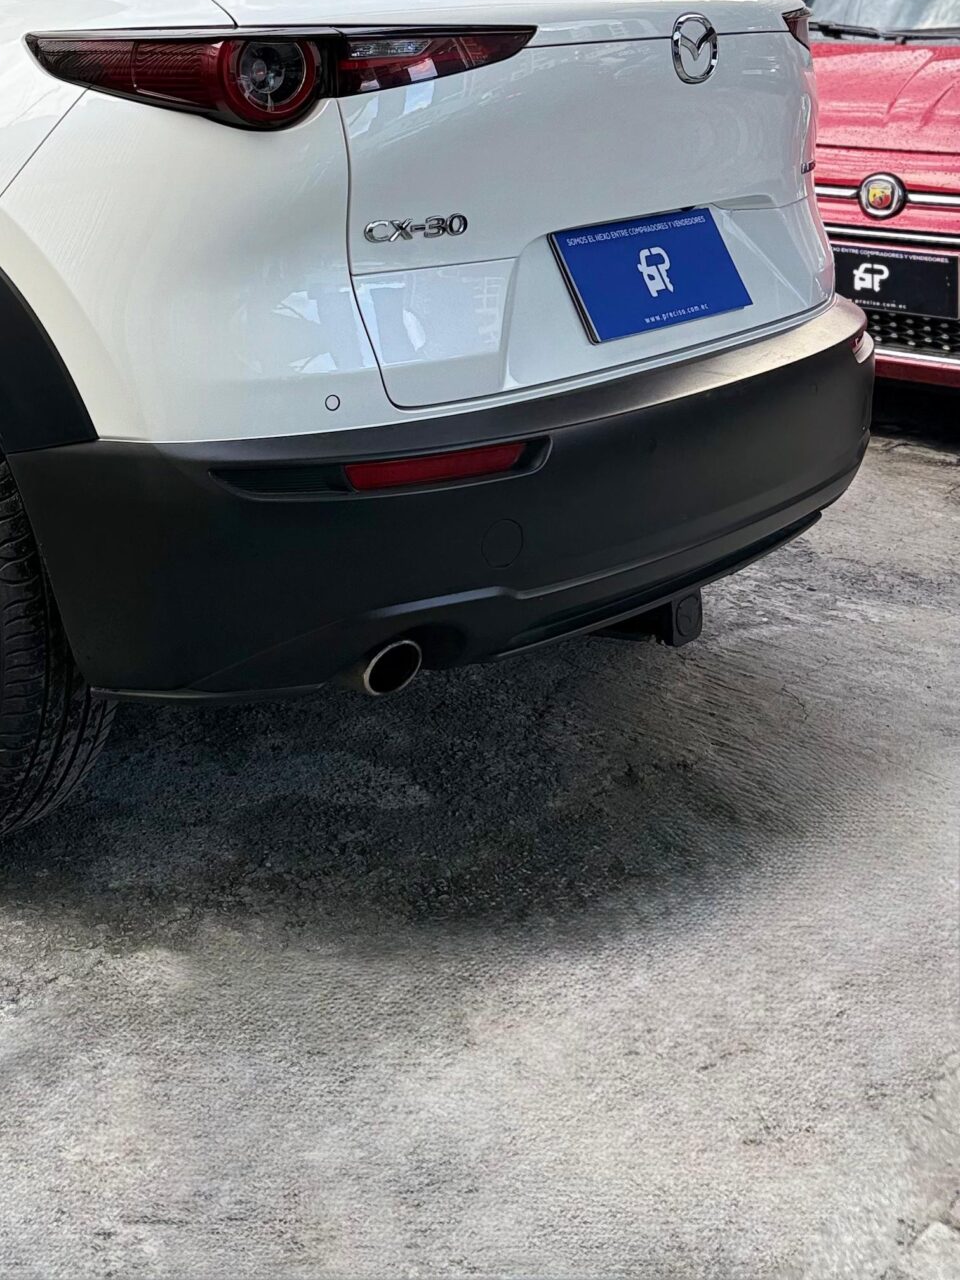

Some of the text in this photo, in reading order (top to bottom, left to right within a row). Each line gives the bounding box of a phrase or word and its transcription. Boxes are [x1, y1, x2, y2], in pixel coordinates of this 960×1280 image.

[363, 212, 468, 243] CX-30
[566, 236, 588, 246] SOMOS
[611, 229, 629, 239] ENTRE
[628, 222, 669, 236] COMPRADORES
[841, 247, 859, 255] ENTRE
[859, 248, 904, 259] COMPRADORES
